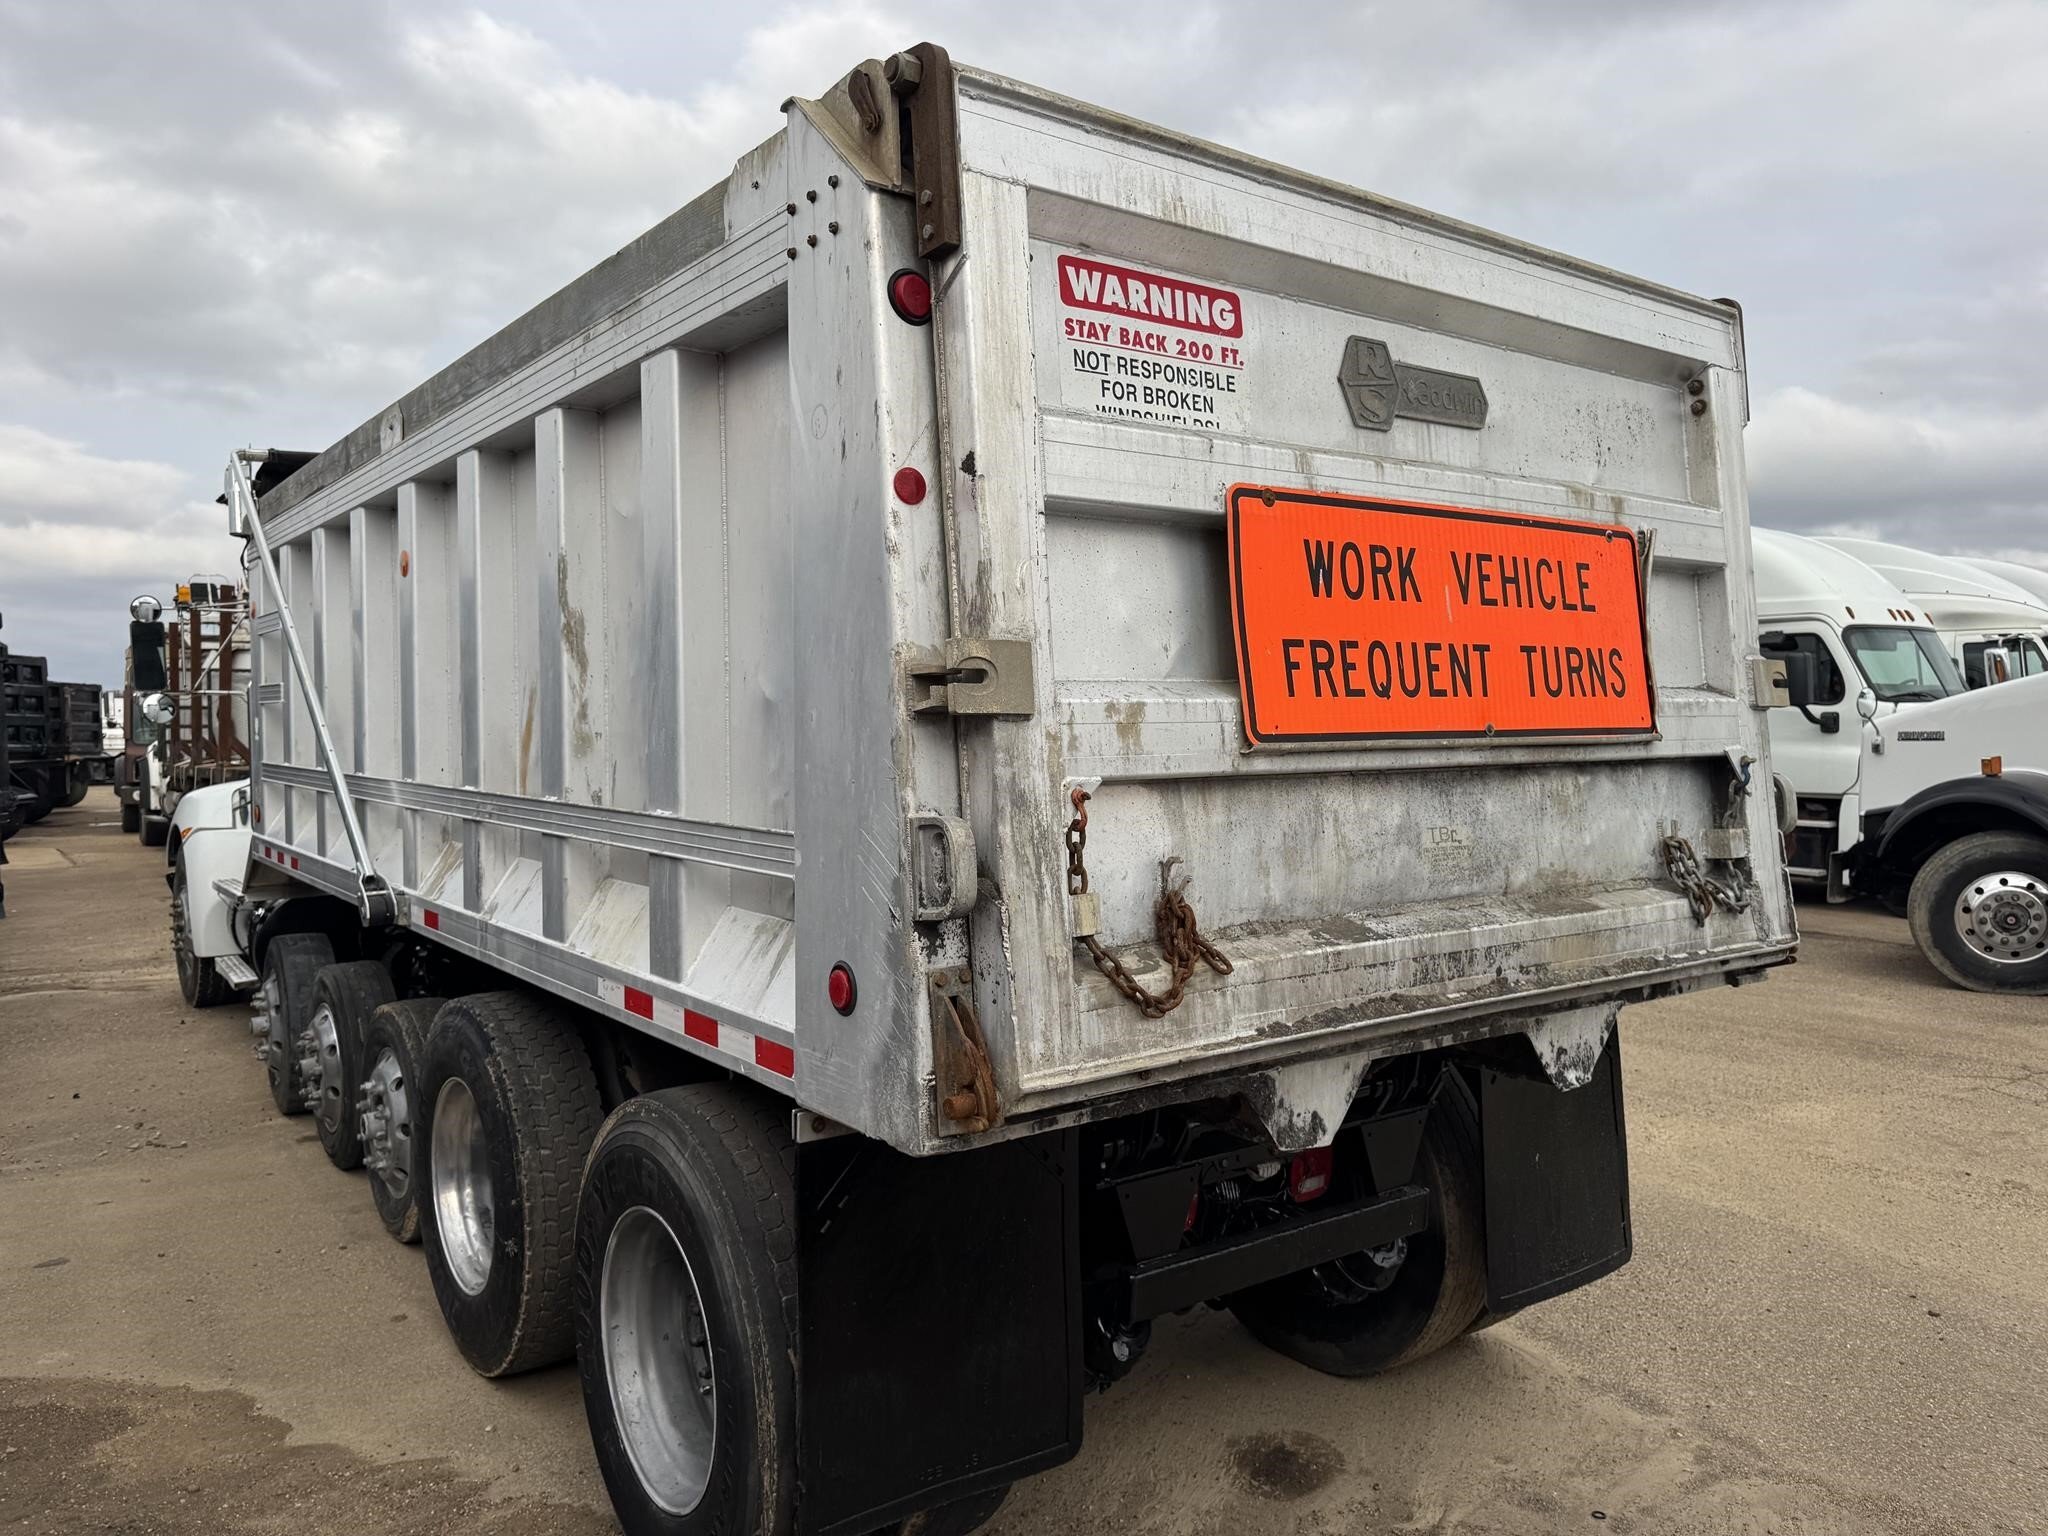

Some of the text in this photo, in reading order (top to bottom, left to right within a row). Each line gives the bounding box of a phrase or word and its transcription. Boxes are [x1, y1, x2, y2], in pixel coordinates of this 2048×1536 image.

[1065, 265, 1236, 330] WARNING
[1064, 317, 1245, 366] STAY BACK 200 FT.
[1073, 348, 1236, 393] NOT RESPONSIBLE
[1101, 379, 1214, 414] FOR BROKEN
[1303, 538, 1597, 613] WORK VEHICLE
[1281, 638, 1627, 700] FREQUENT TURNS
